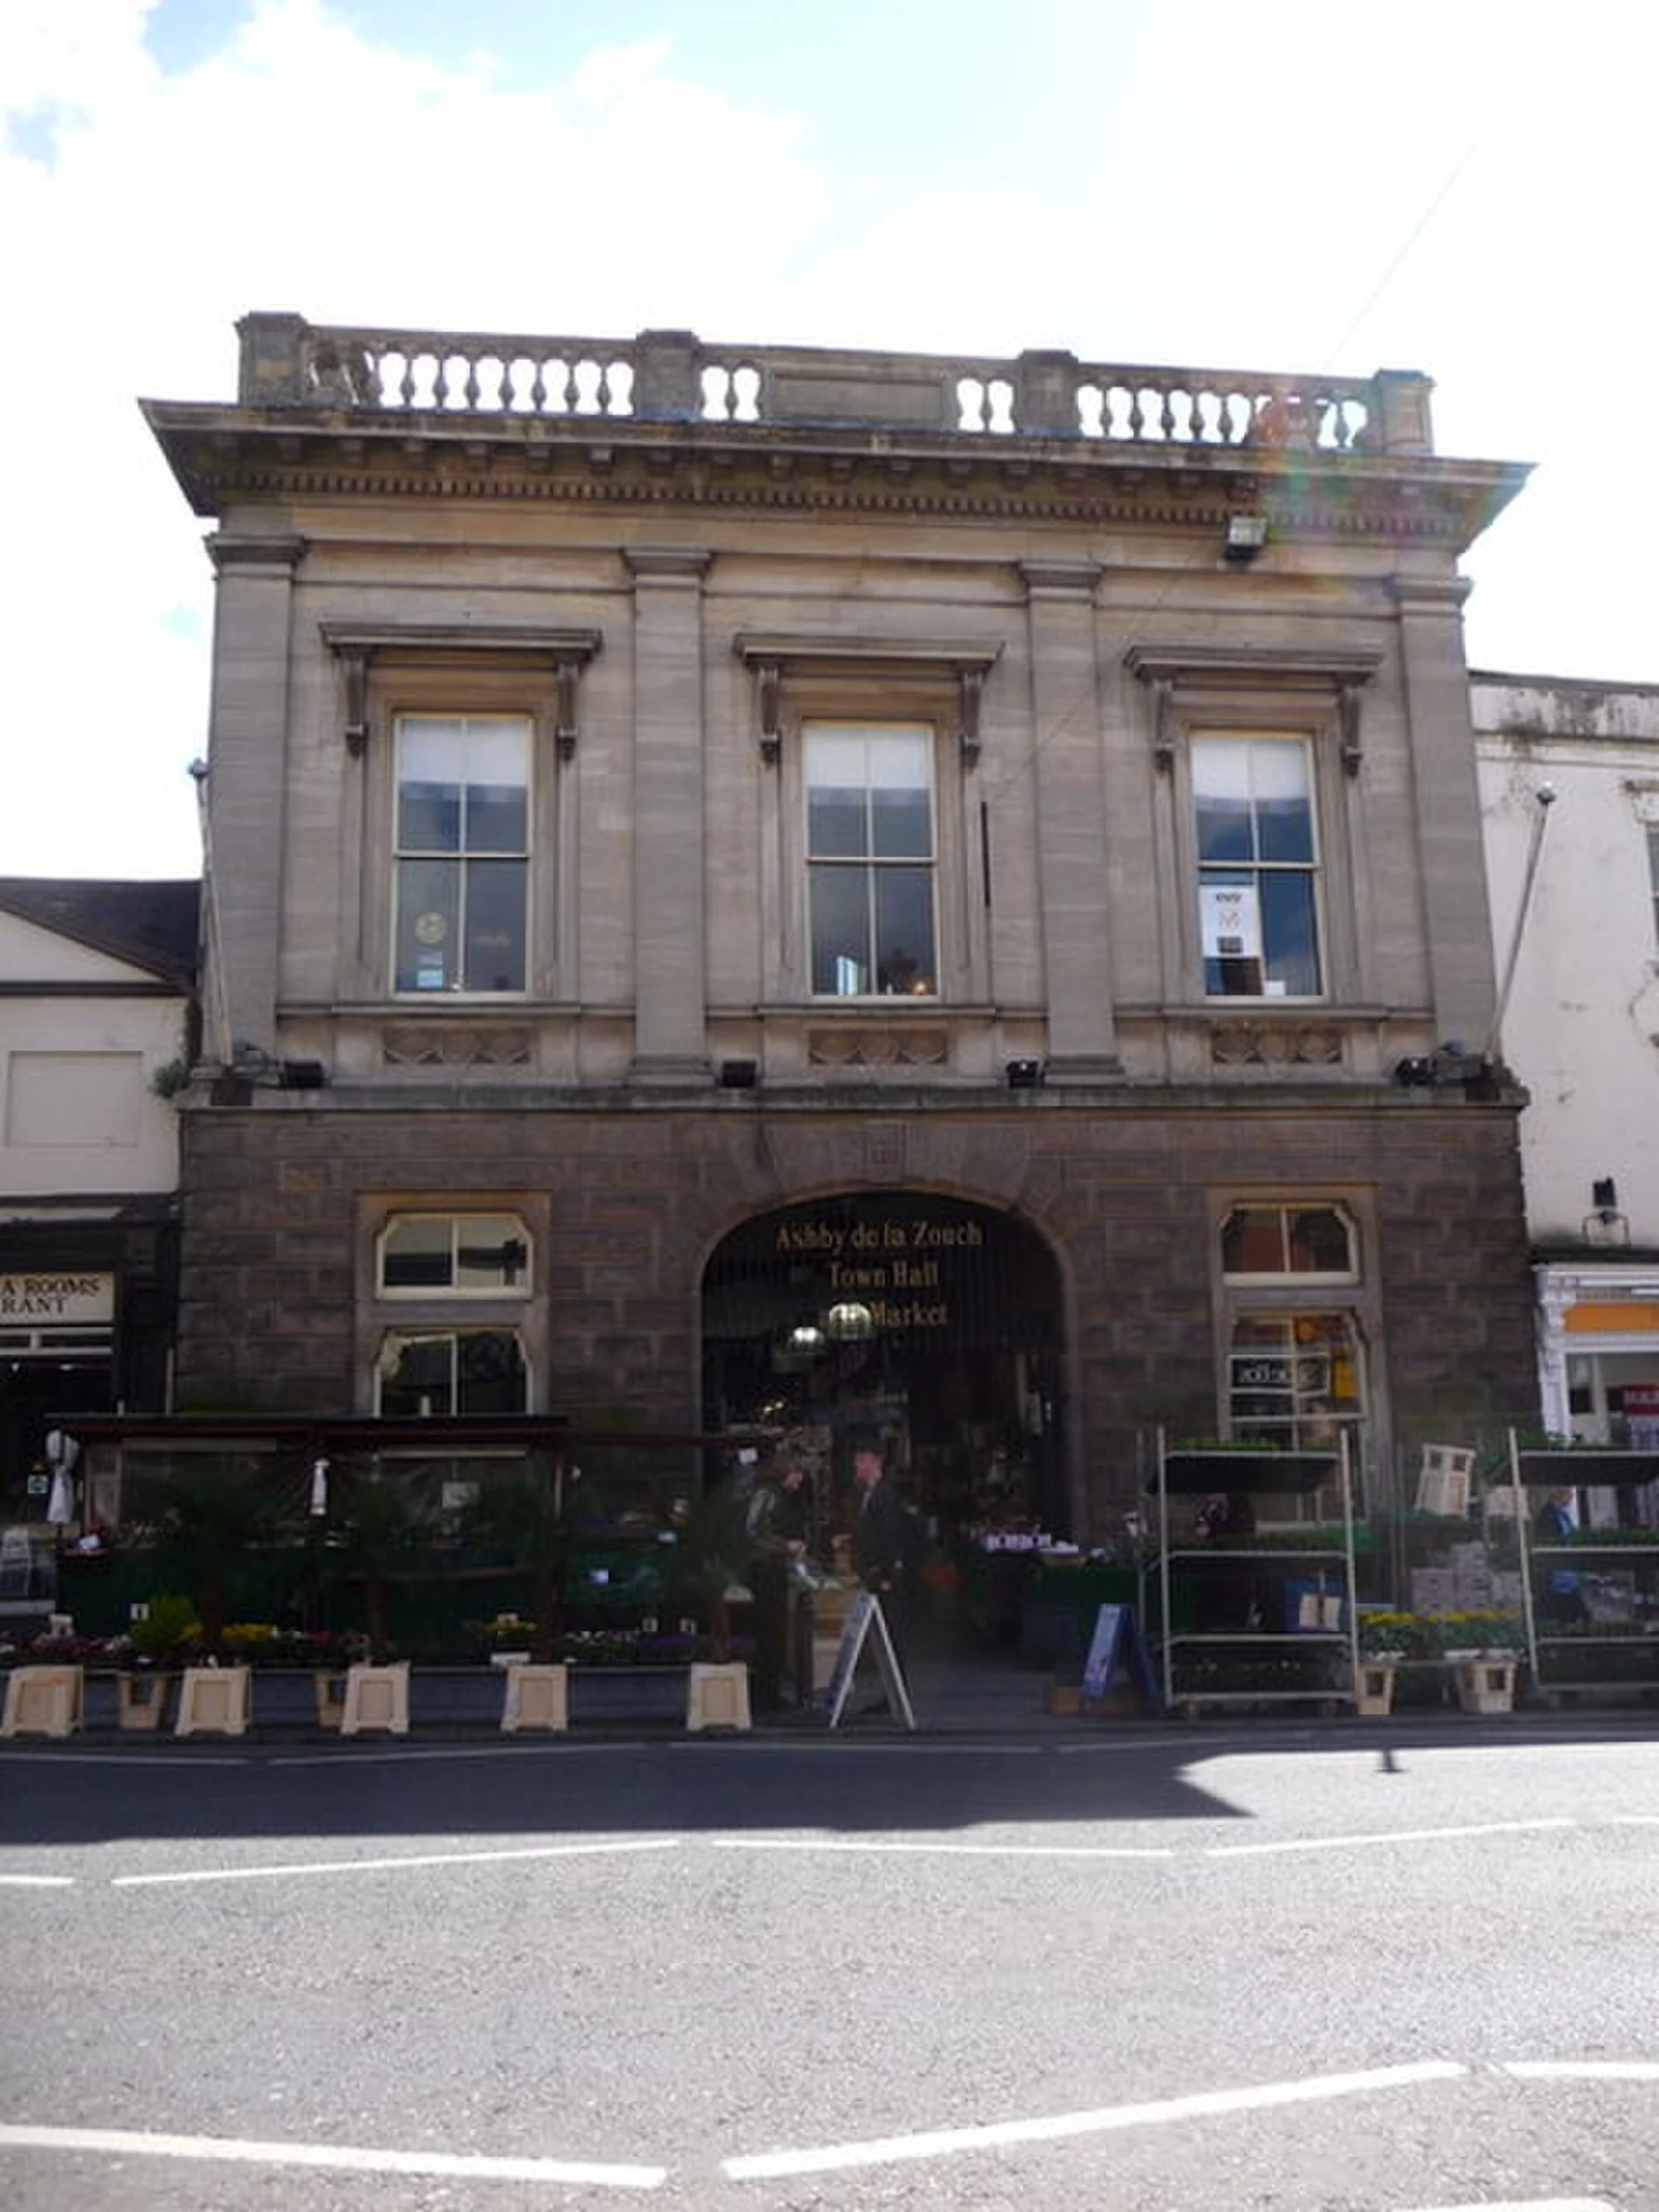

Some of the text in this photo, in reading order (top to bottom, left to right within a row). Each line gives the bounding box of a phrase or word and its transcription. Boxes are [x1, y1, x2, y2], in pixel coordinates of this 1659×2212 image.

[912, 1220, 984, 1246] Zouch
[830, 1260, 940, 1288] Town Hall
